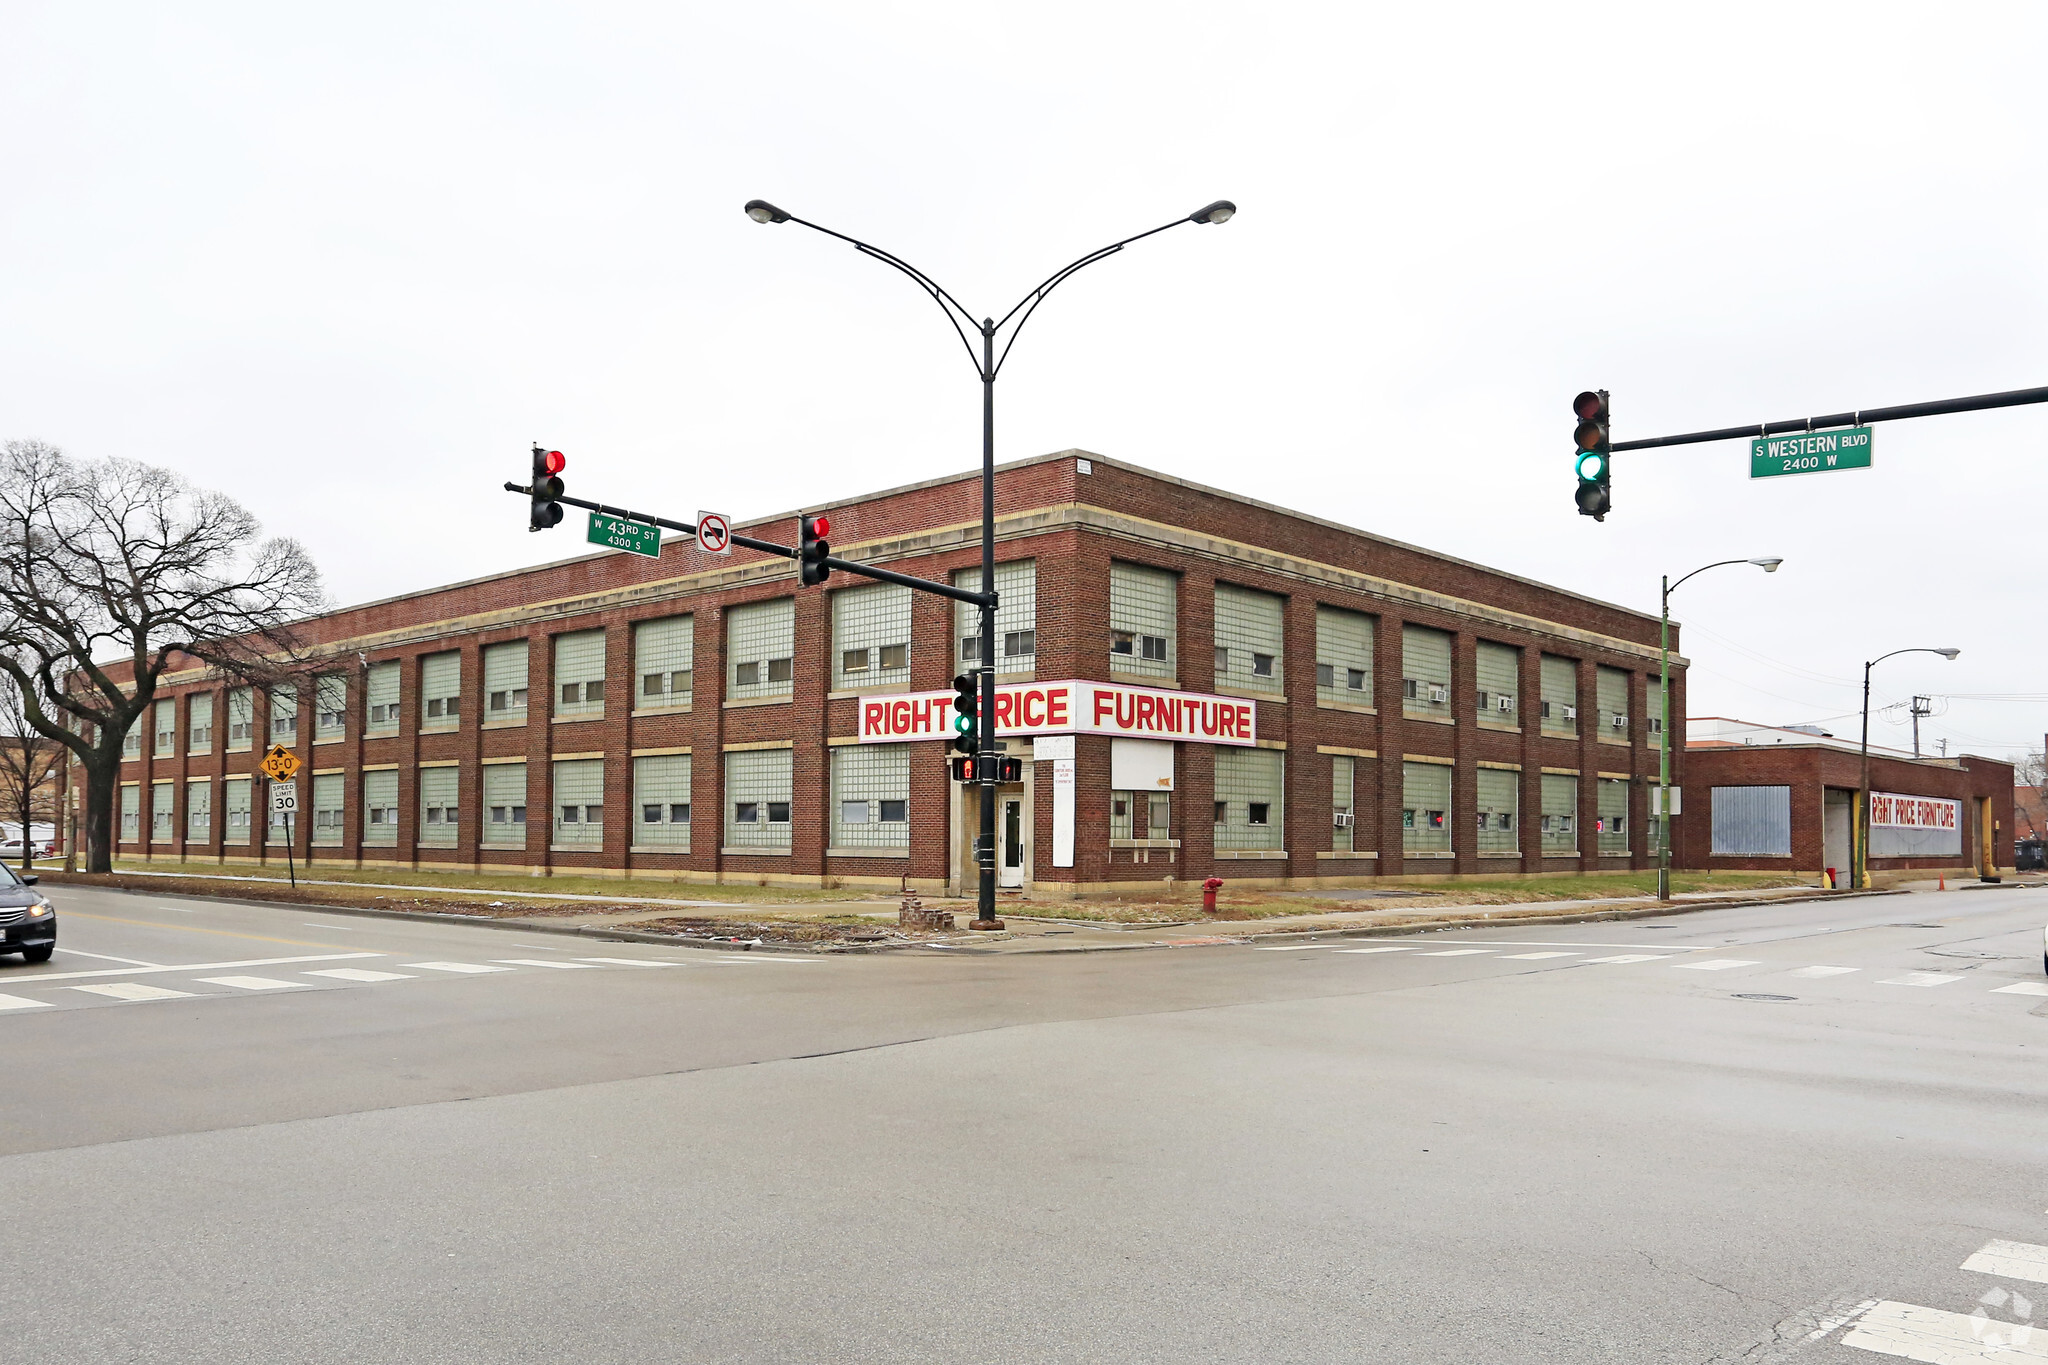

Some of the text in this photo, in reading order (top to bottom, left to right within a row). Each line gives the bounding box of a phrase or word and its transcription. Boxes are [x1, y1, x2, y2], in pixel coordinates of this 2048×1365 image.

[1756, 434, 1868, 458] S WESTERN BLVD
[1783, 455, 1837, 471] 2400 W
[594, 519, 655, 541] W 43RD ST
[608, 536, 641, 550] 4300 S
[865, 688, 1251, 739] RIGHT RICE FURNITURE
[273, 784, 294, 792] SPEED
[275, 797, 294, 809] 30
[1872, 796, 1954, 828] RGHT PRICE FURNITURE
